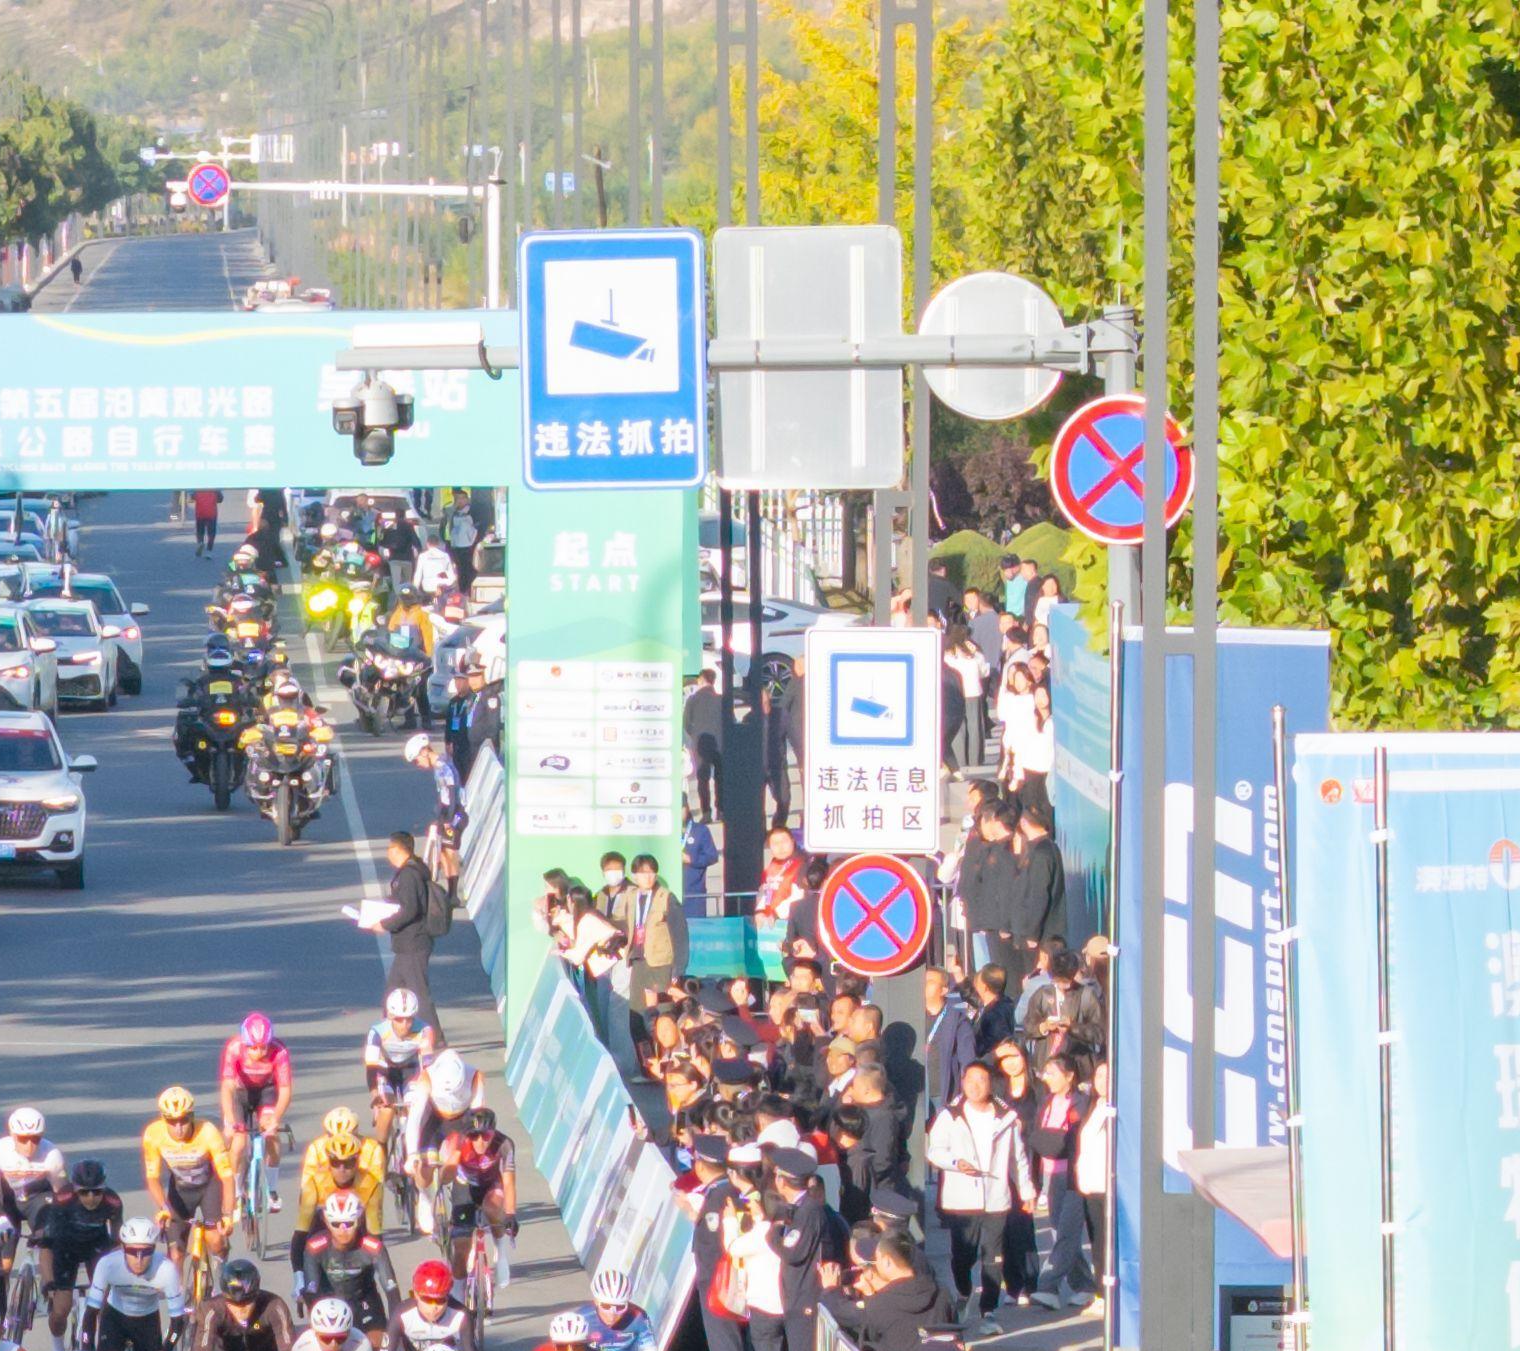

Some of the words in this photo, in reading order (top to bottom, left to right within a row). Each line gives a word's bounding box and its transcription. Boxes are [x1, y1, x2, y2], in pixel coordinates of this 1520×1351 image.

[534, 419, 695, 457] 违法抓拍
[553, 533, 637, 567] 起点
[549, 573, 640, 592] START
[817, 765, 929, 793] 违法信息
[823, 804, 923, 831] 抓拍区
[1263, 784, 1290, 1147] w.ccnsport.com
